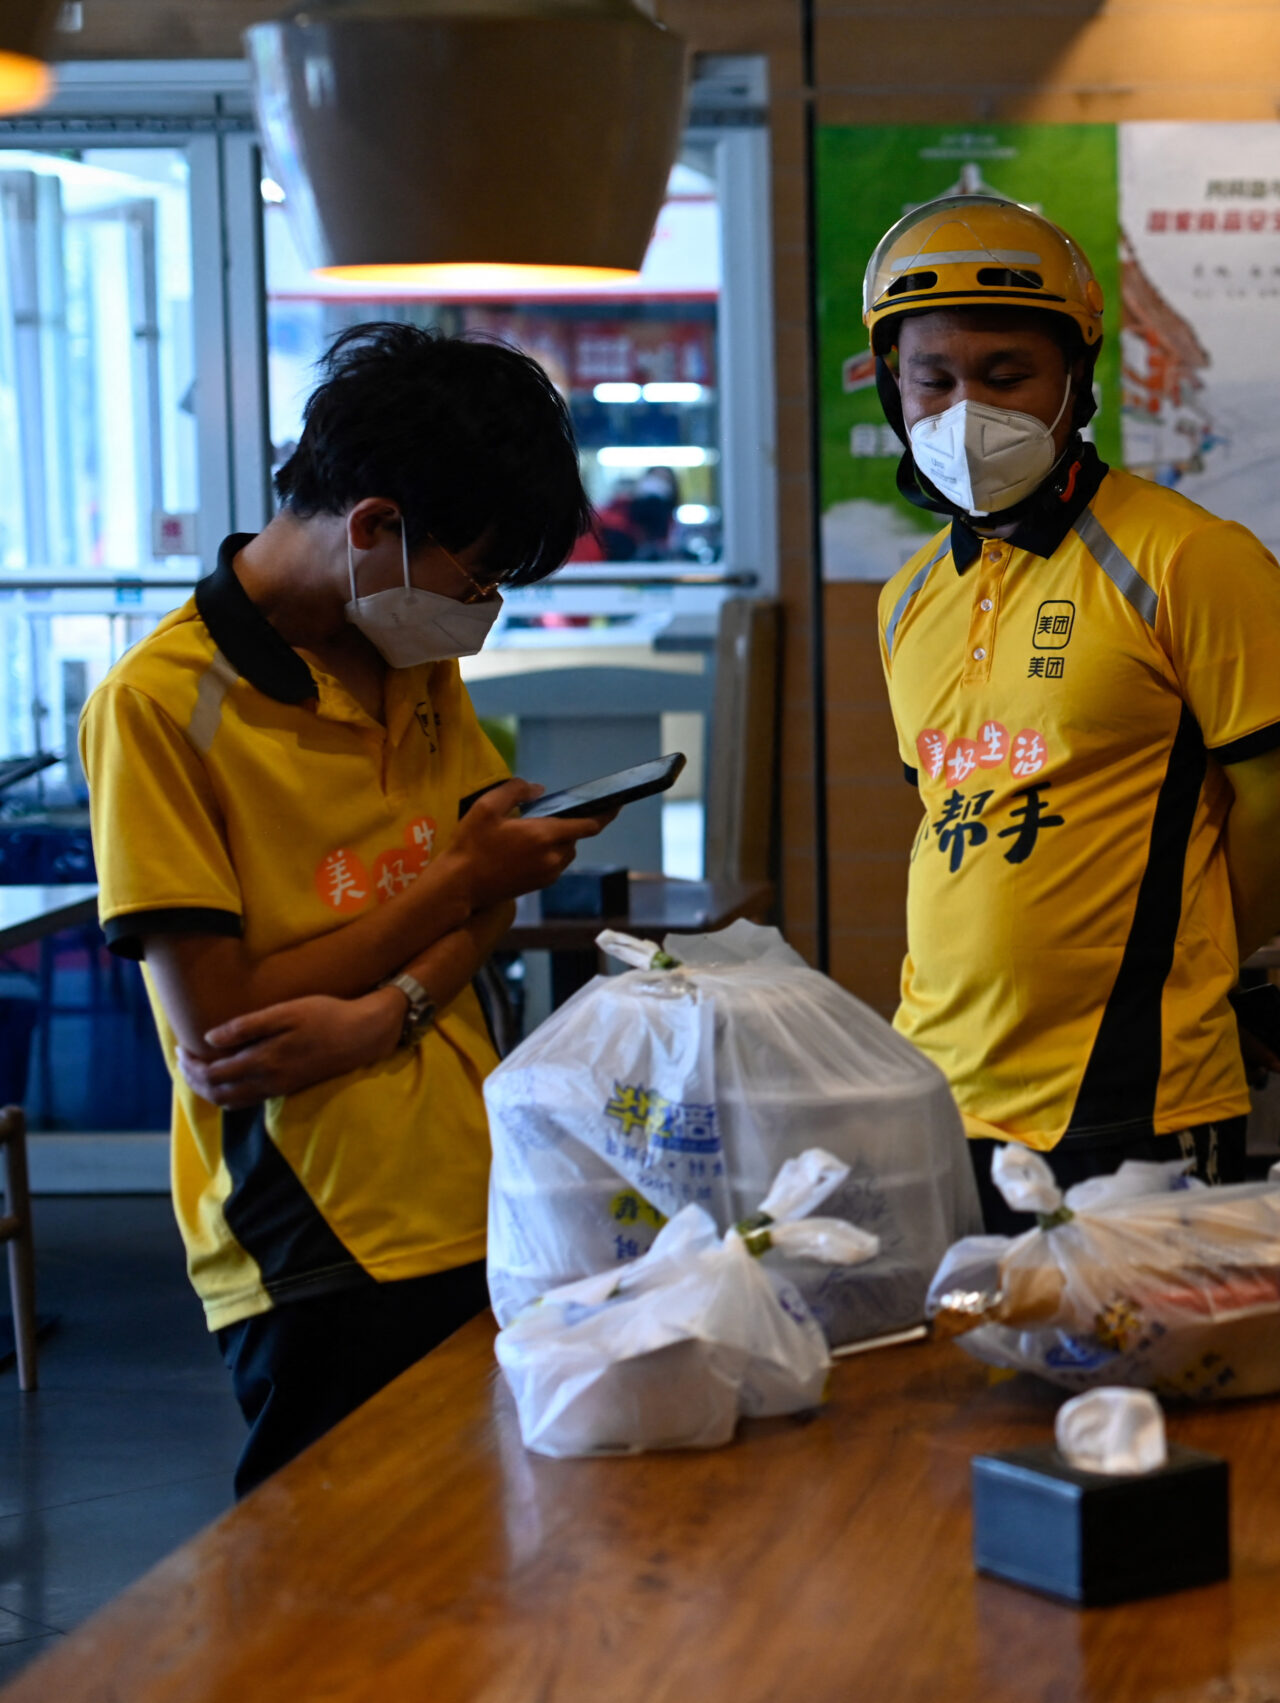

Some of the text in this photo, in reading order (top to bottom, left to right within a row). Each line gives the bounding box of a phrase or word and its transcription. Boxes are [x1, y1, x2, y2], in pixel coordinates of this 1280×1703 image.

[1036, 615, 1070, 635] 美团
[1026, 656, 1066, 679] 美团
[922, 721, 1046, 781] 美好生活
[910, 781, 1066, 874] 帮手
